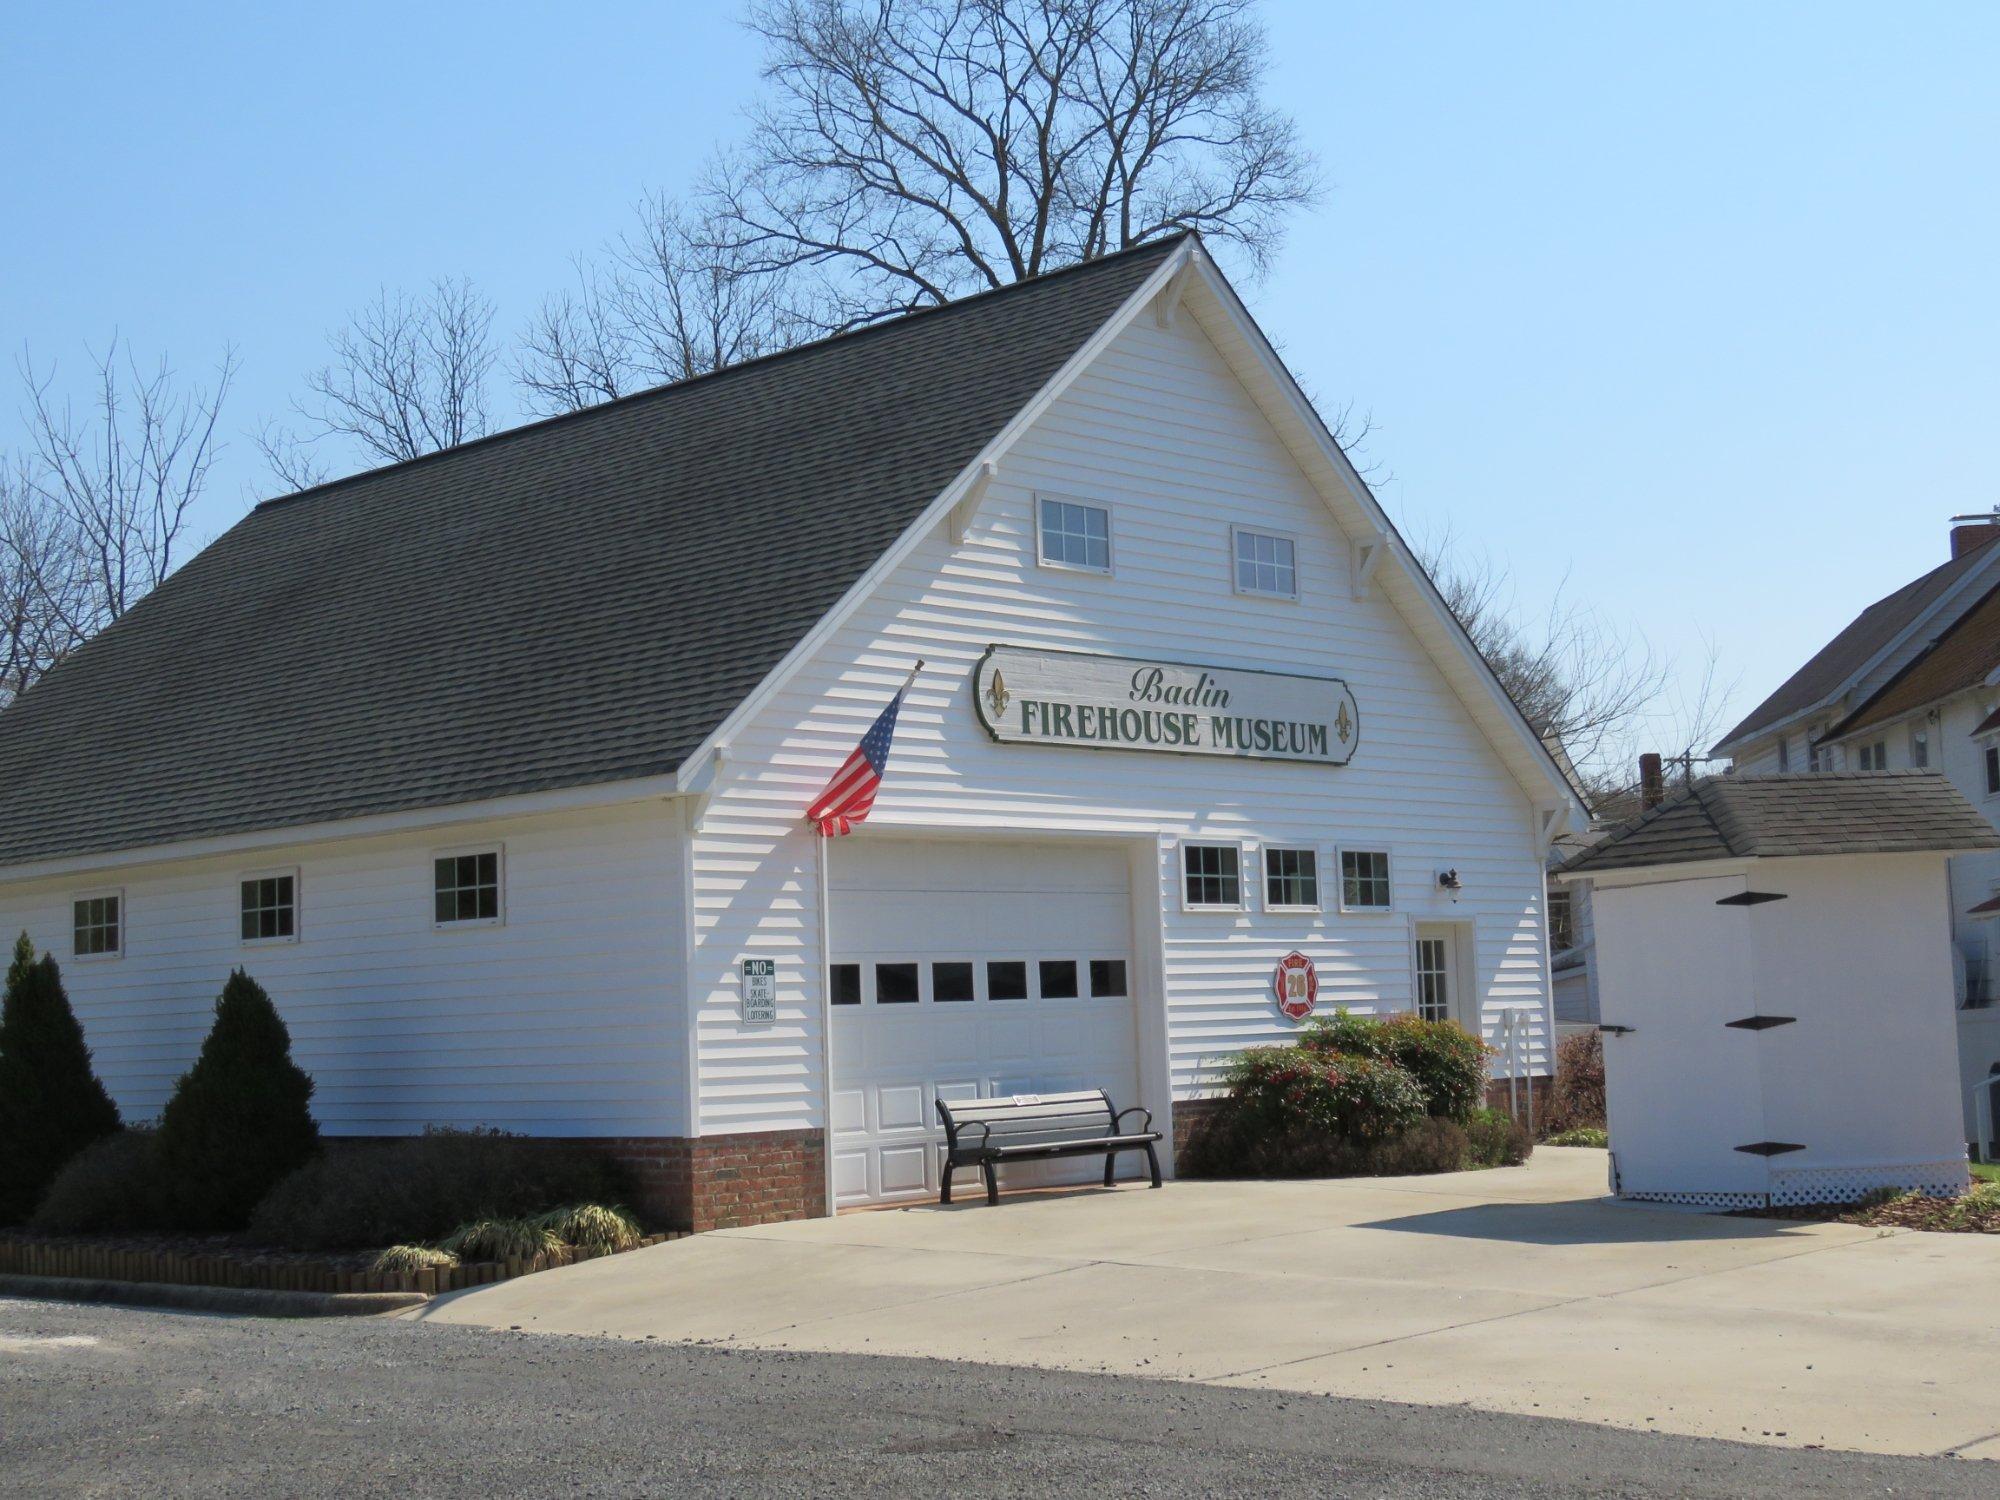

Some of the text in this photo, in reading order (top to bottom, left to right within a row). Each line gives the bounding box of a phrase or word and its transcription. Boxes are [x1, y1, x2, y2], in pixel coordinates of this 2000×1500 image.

[1129, 666, 1232, 709] Badin
[1020, 700, 1328, 756] FIREHOUSE MUSEUM
[752, 961, 767, 975] NO
[752, 977, 767, 986] BIKES
[746, 999, 773, 1008] BOARDING
